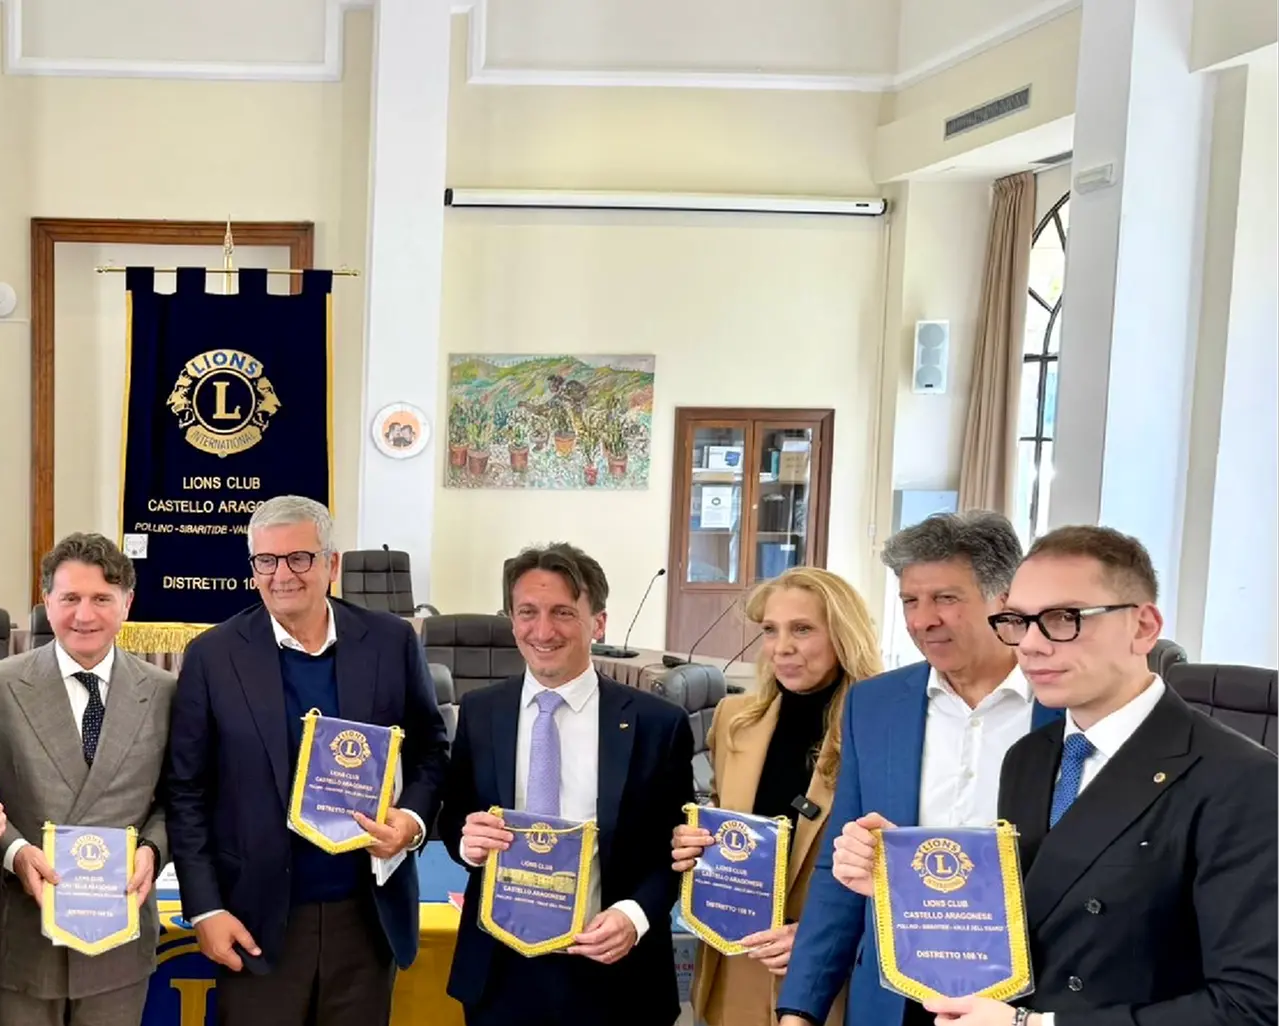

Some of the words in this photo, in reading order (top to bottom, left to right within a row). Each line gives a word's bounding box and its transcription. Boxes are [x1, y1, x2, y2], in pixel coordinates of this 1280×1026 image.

[191, 352, 259, 376] LIONS
[212, 381, 241, 420] L
[191, 429, 256, 451] INTERNATIONAL
[183, 476, 222, 489] LIONS
[226, 476, 261, 490] CLUB
[147, 499, 214, 513] CASTELLO
[134, 522, 174, 533] POLLINO
[162, 575, 238, 590] DISTRETTO
[243, 577, 258, 590] 10
[345, 741, 356, 756] L
[729, 833, 741, 849] L
[924, 838, 959, 851] LIONS
[86, 845, 96, 857] L
[935, 854, 952, 874] L
[923, 899, 946, 907] LIONS
[947, 900, 969, 908] CLUB
[903, 911, 944, 919] CASTELLO
[944, 912, 992, 920] ARAGONESE
[916, 950, 960, 959] DISTRETTO
